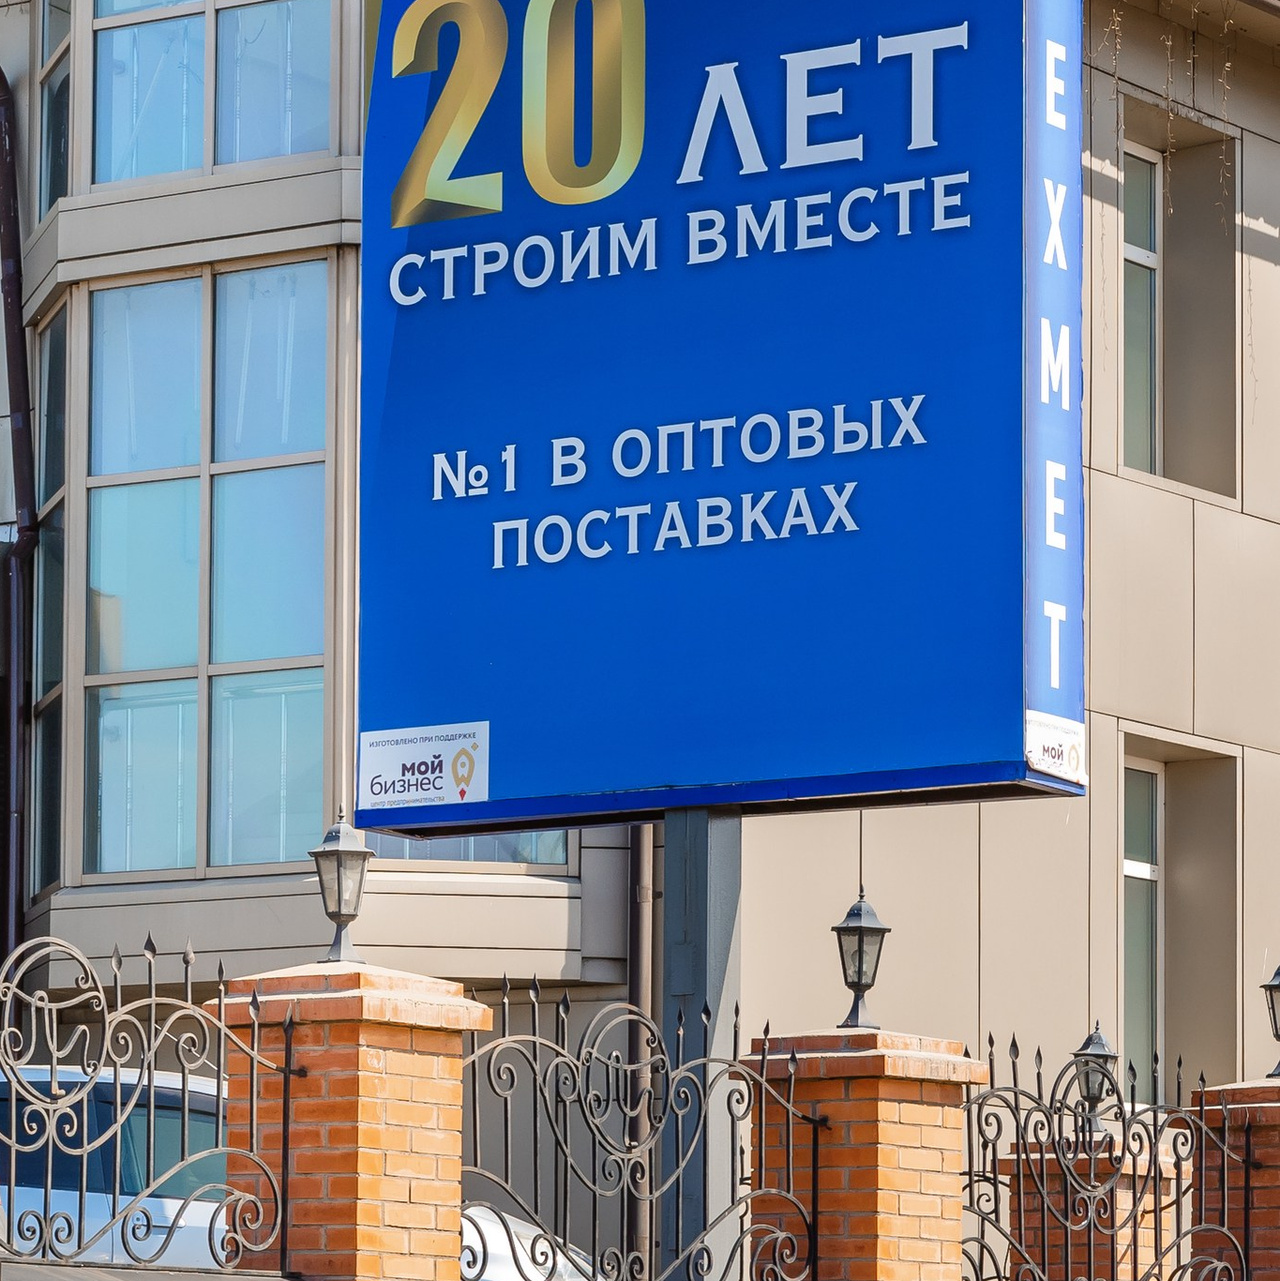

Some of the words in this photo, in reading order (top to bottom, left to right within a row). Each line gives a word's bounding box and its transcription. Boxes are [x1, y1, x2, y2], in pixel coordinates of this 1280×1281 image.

[676, 20, 969, 185] ЛЕТ
[389, 218, 658, 306] СТРОИМ
[686, 170, 972, 266] ВМЕСТЕ
[551, 437, 588, 487] В
[612, 394, 928, 478] ОПТОВЫХ
[492, 481, 860, 569] ПОСТАВКАХ
[369, 736, 418, 748] ИЗГОТОВЛЕНО
[419, 735, 434, 744] ПРИ
[435, 731, 477, 742] ПОДДЕРЖКЕ
[370, 774, 444, 796] бизнес
